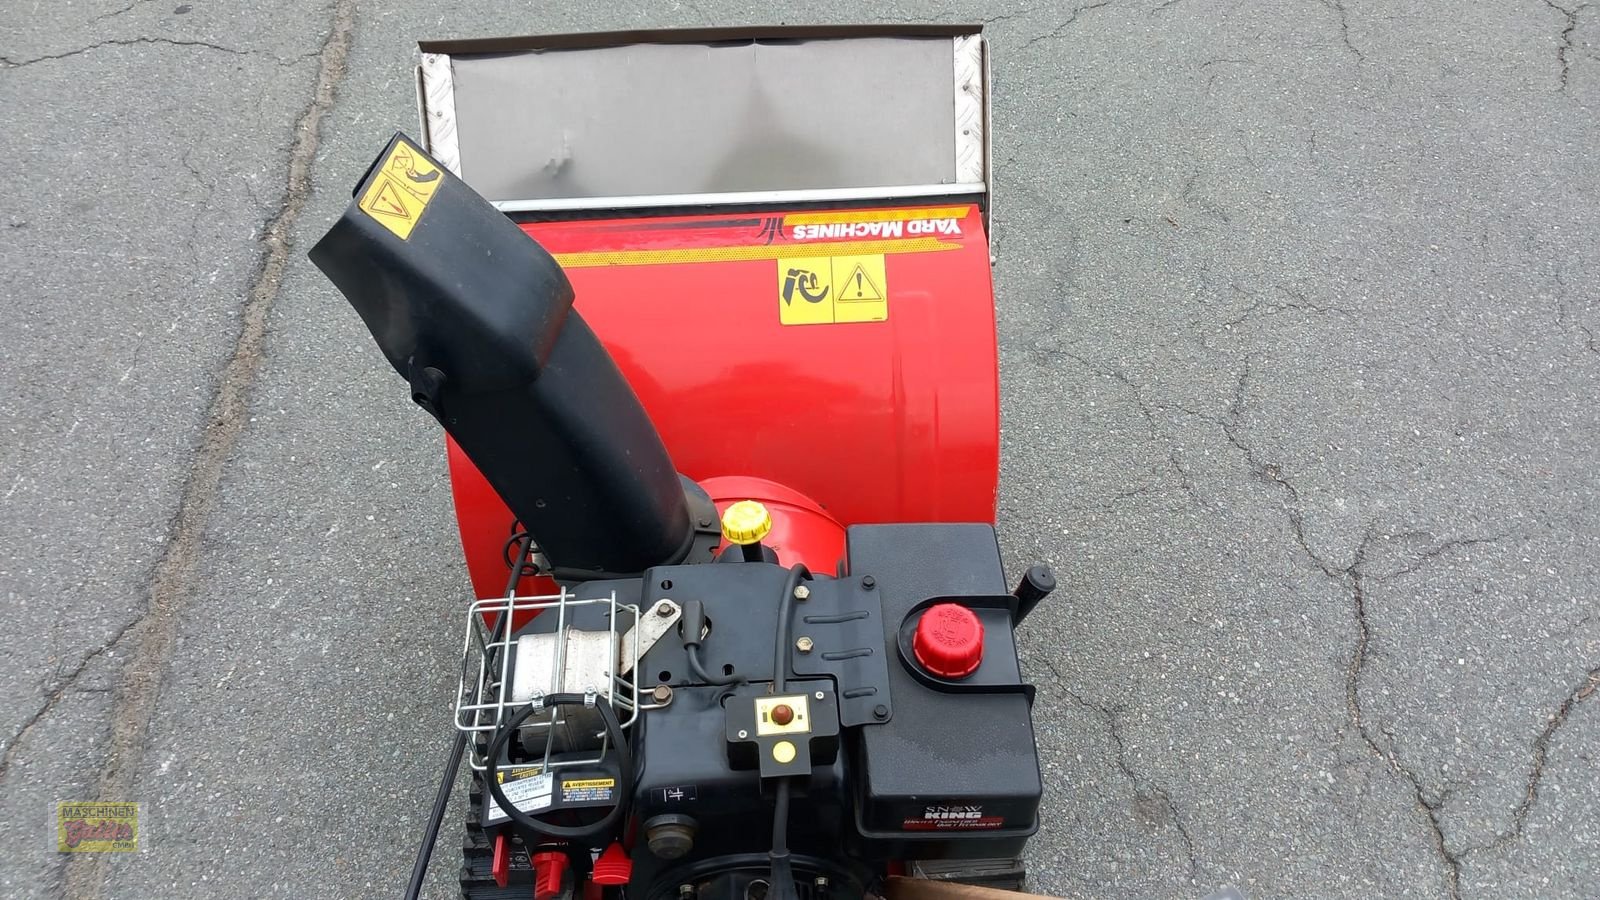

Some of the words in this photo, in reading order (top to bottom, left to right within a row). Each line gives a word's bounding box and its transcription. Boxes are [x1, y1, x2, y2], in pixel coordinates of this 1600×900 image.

[793, 220, 902, 240] MACHINES
[907, 218, 962, 235] YARD
[572, 780, 613, 788] AVERTISSEMENT
[924, 811, 982, 819] KING
